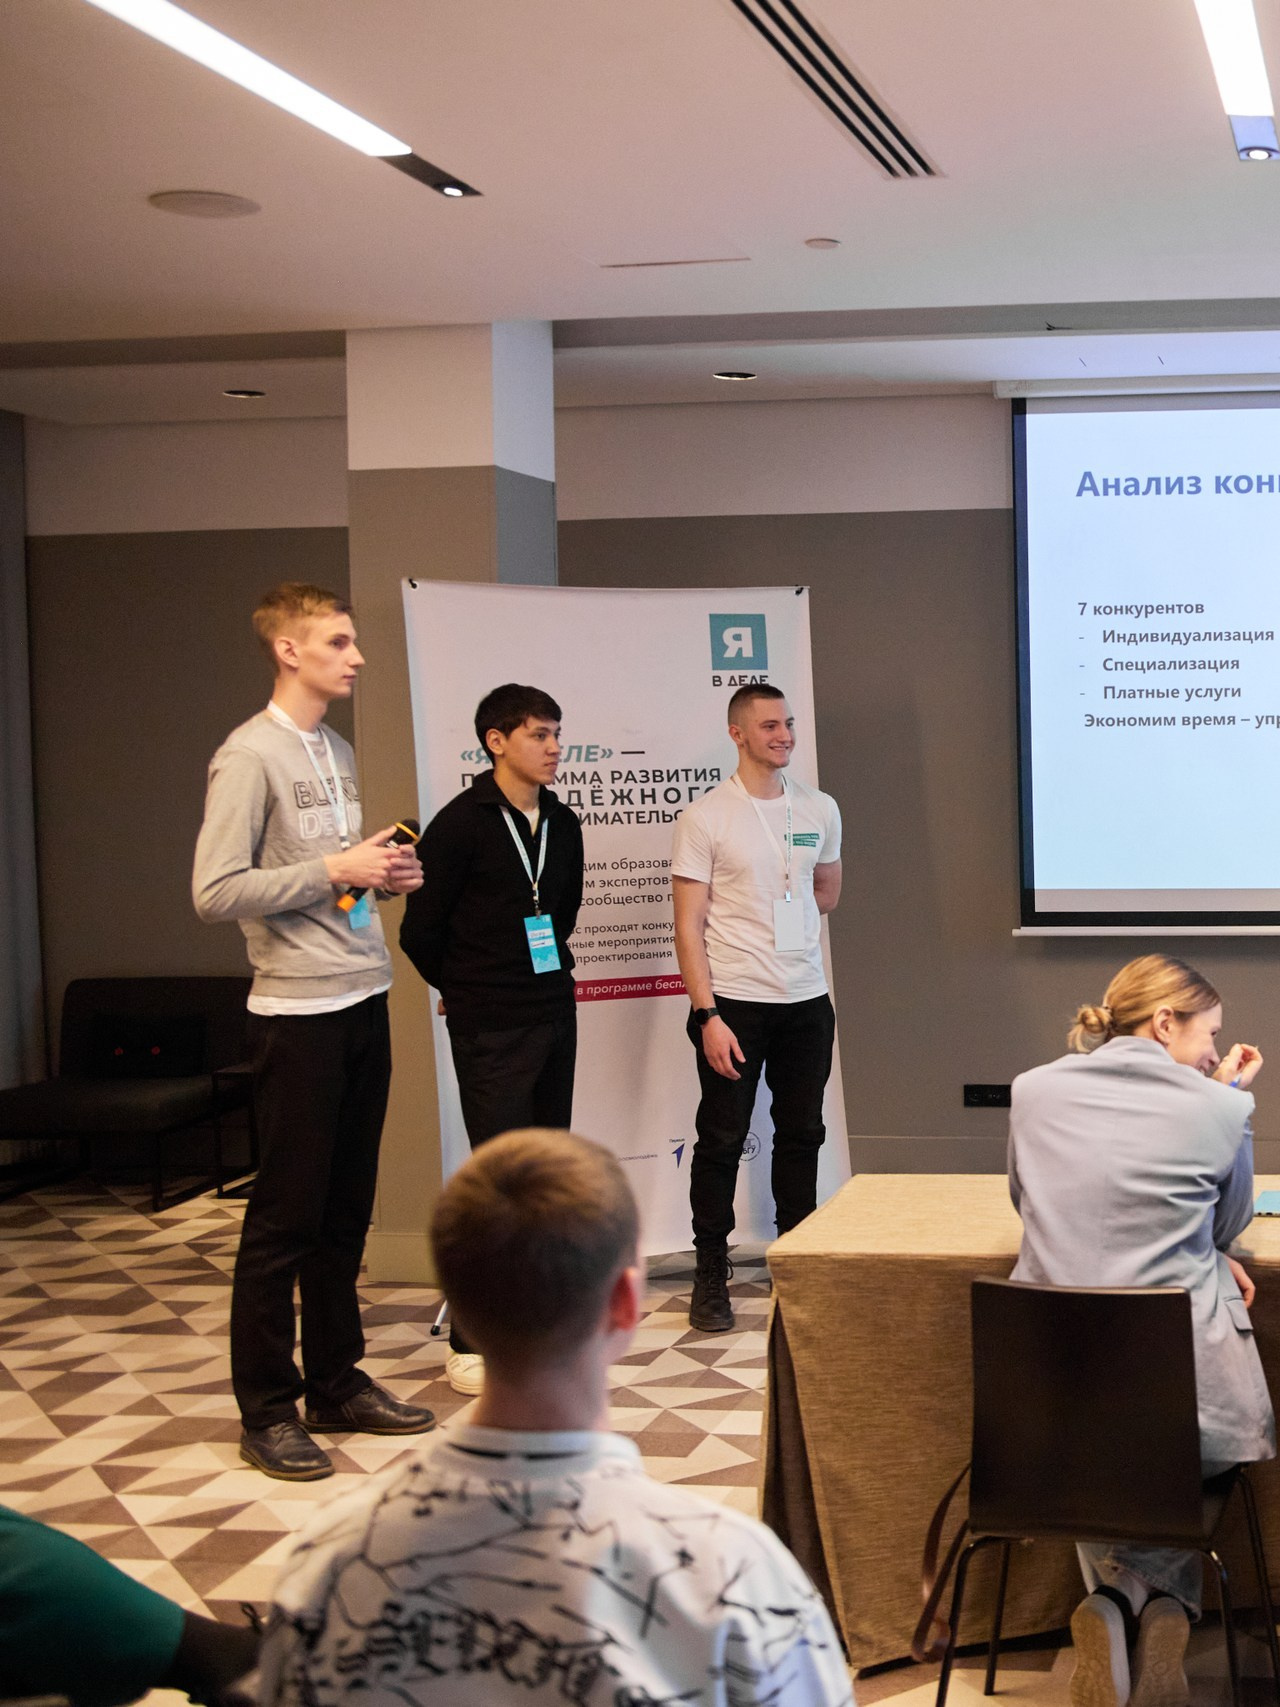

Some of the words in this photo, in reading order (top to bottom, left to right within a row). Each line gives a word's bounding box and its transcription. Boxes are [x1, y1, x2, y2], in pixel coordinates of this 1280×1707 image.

[1076, 471, 1202, 497] Анализ
[1078, 602, 1087, 616] 7
[1093, 603, 1205, 619] конкурентов
[722, 626, 754, 658] Я
[1102, 629, 1275, 646] Индивидуализация
[1102, 657, 1240, 674] Специализация
[711, 675, 723, 687] В
[1103, 685, 1181, 699] Платные
[1185, 686, 1242, 702] услуги
[1084, 713, 1176, 728] Экономим
[1181, 714, 1236, 730] время
[610, 768, 721, 785] РАЗВИТИЯ
[585, 924, 639, 936] проходят
[598, 935, 675, 949] мероприятия
[576, 951, 673, 965] проектирования
[587, 984, 652, 996] программе
